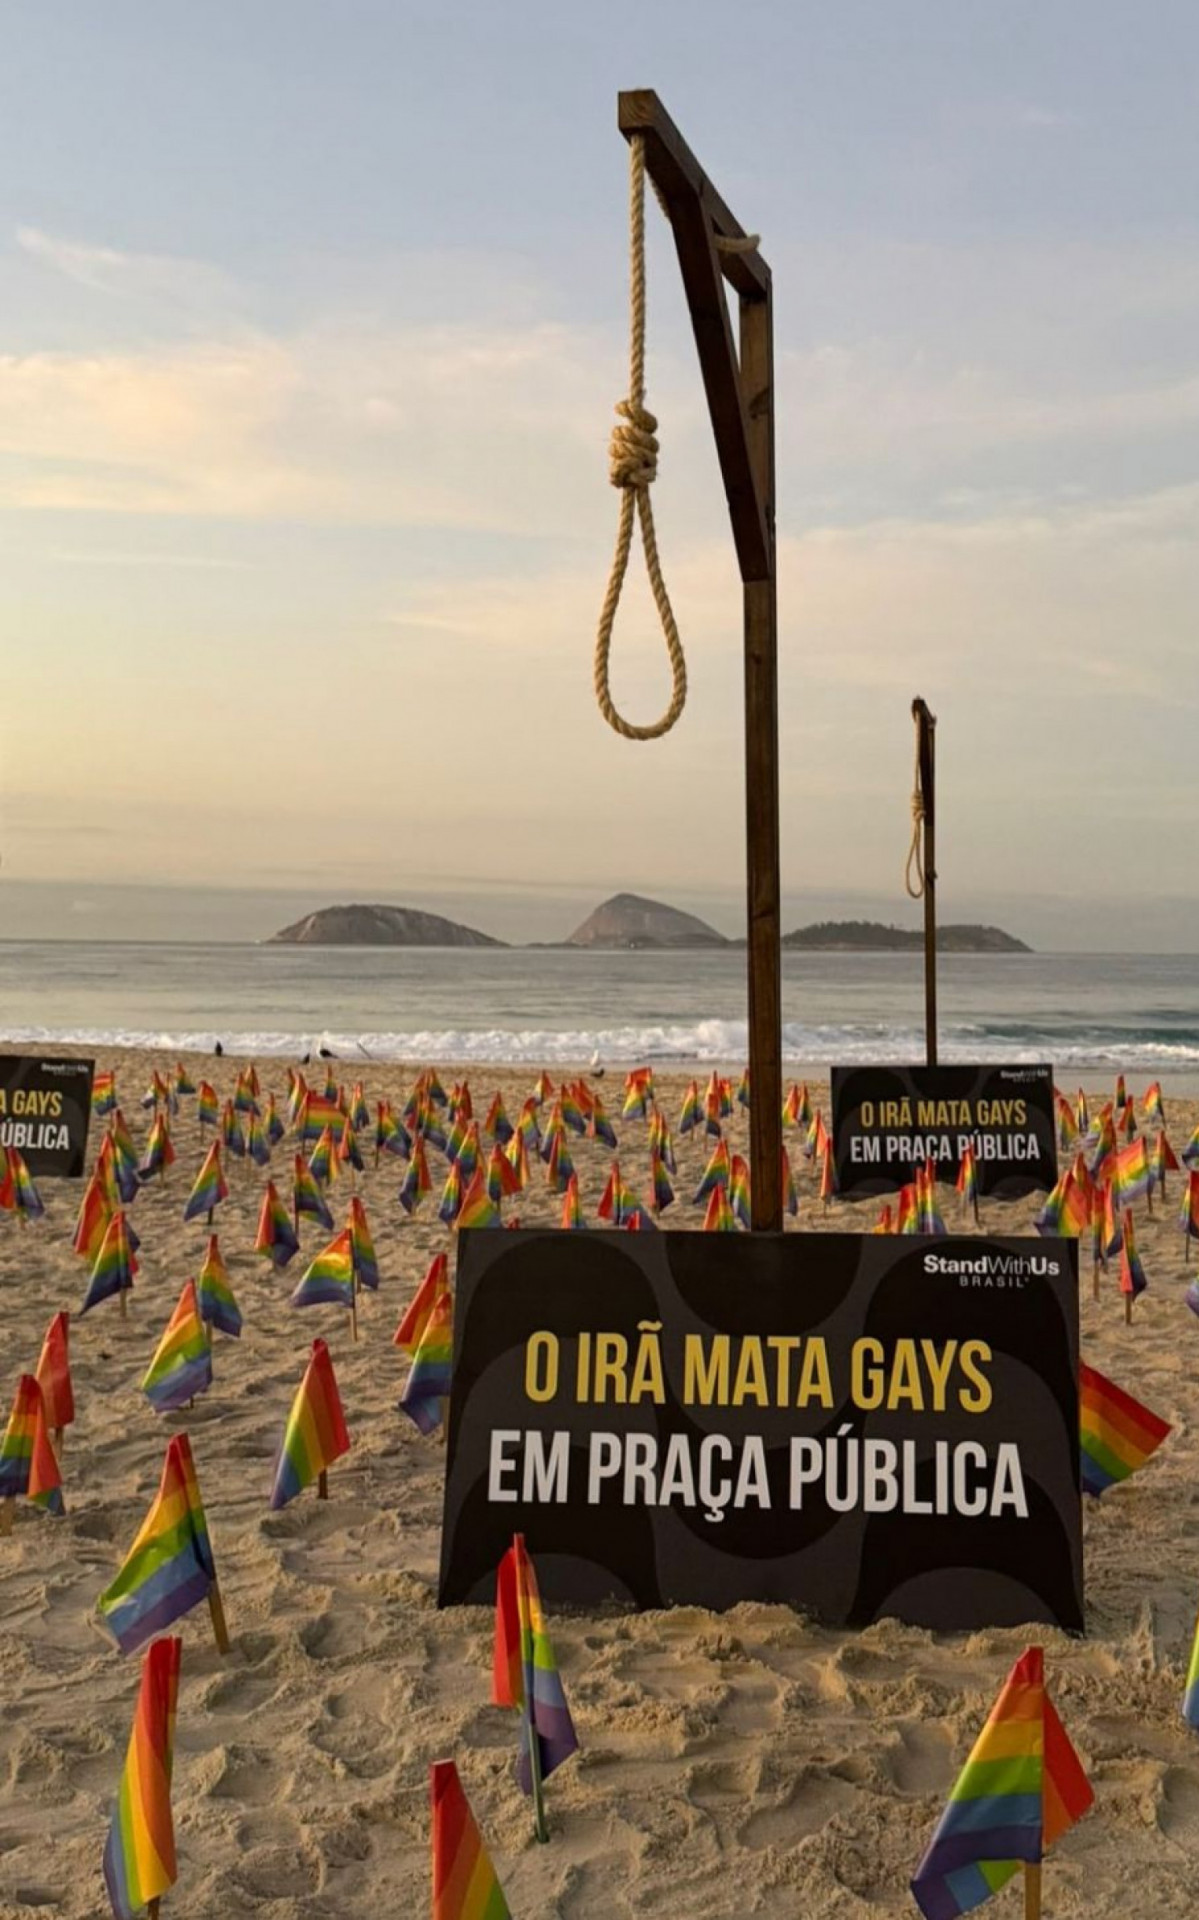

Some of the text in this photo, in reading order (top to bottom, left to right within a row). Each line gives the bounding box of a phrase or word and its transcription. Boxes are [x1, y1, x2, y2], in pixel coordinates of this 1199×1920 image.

[12, 1090, 62, 1116] GAYS
[861, 1097, 1027, 1127] O IRÃ MATA GAYS
[0, 1117, 69, 1150] ÚBLICA
[851, 1136, 880, 1162] EM
[924, 1254, 1060, 1275] StandWithUs
[959, 1275, 1025, 1288] BRASIL
[526, 1321, 993, 1412] O IRÃ MATA GAYS
[488, 1424, 1029, 1522] EM PRAÇA PÚBLICA
